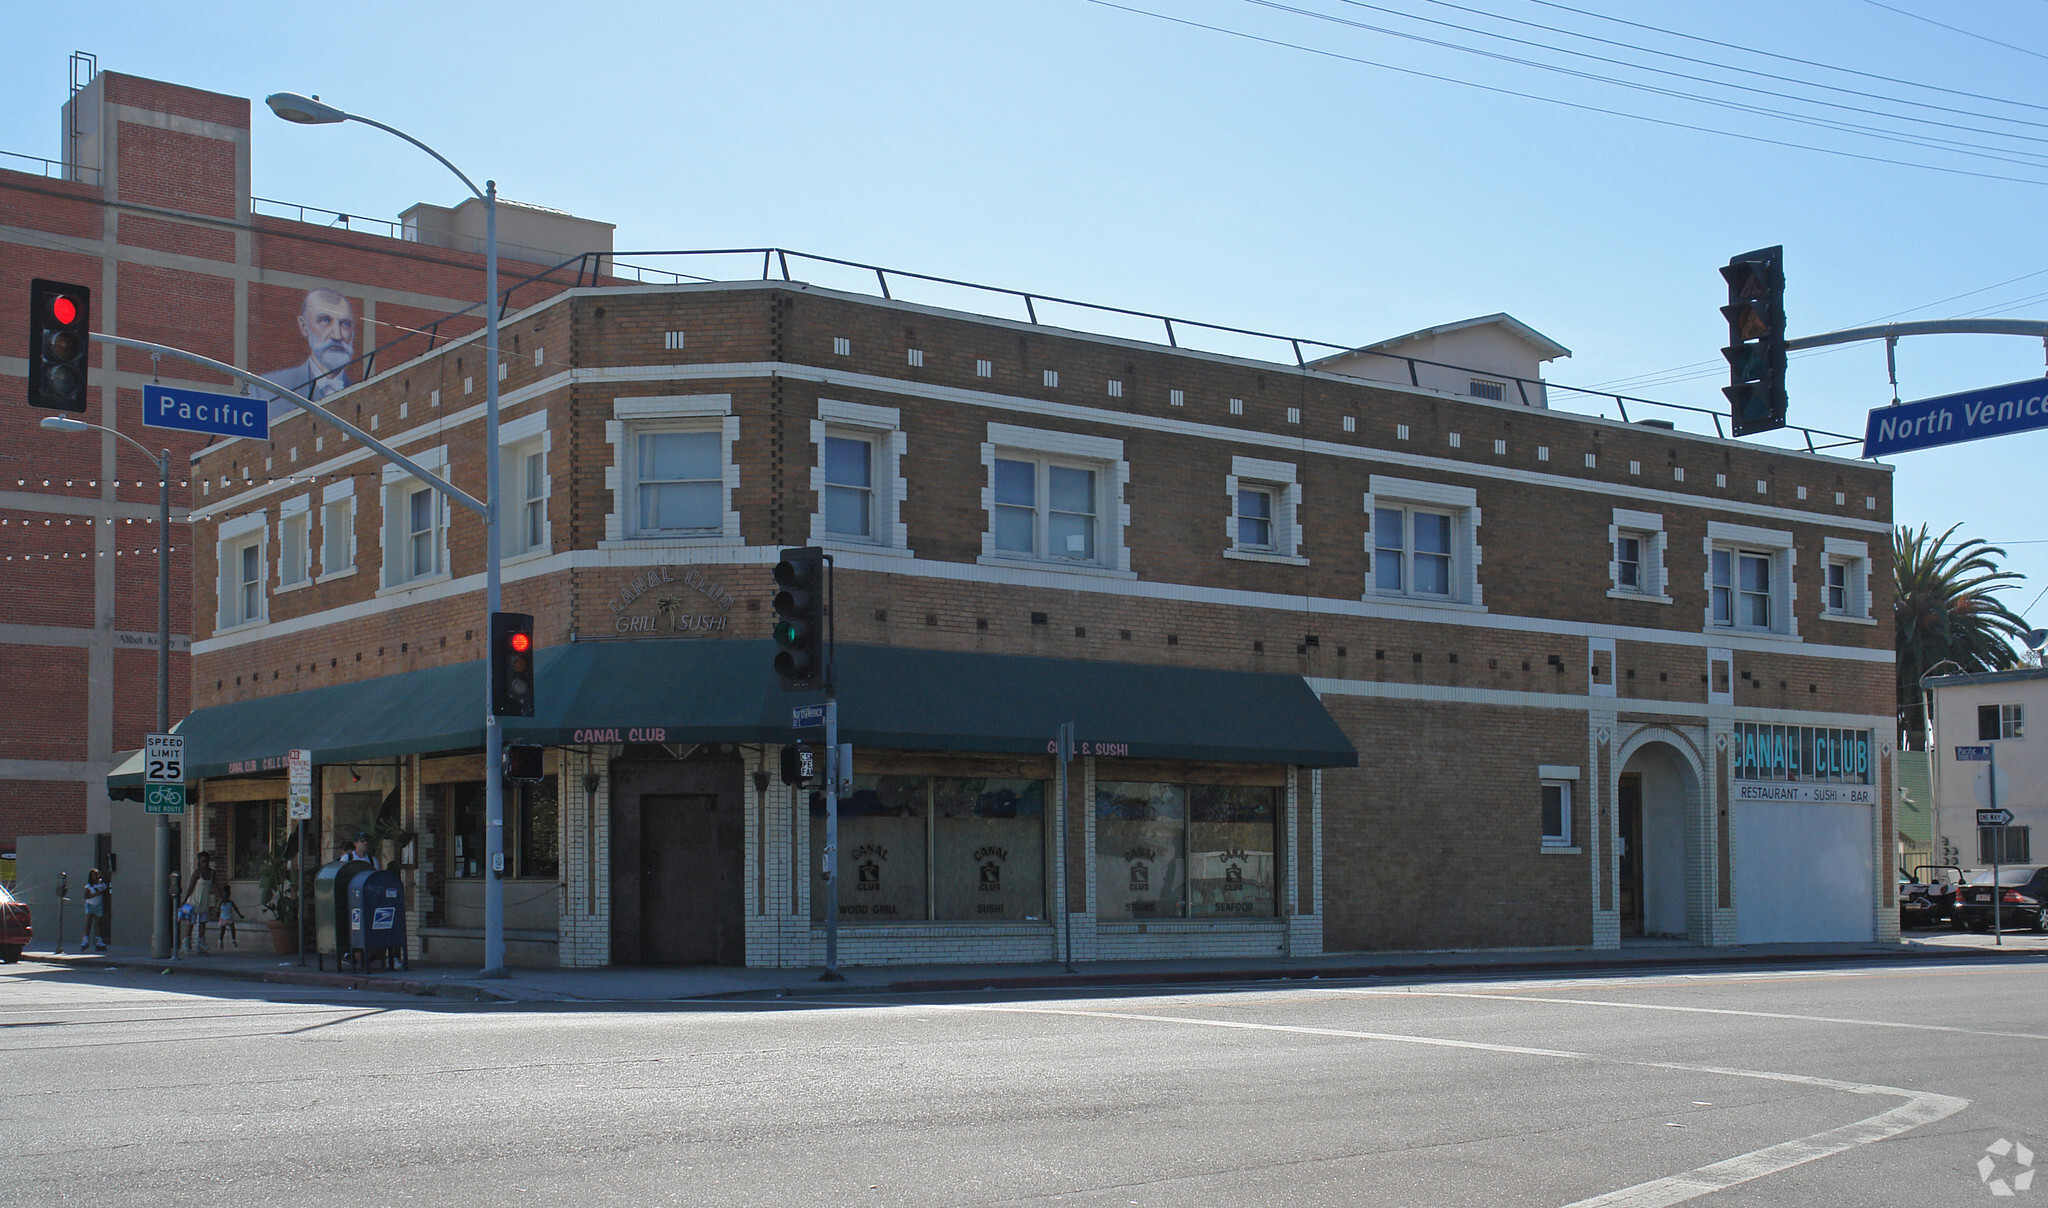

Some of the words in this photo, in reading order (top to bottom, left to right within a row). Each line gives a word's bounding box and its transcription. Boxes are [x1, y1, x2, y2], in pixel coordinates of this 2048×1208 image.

[160, 395, 254, 427] Pacific
[1878, 408, 1953, 443] North
[608, 566, 673, 613] CANAL
[684, 569, 734, 611] CLUB
[615, 615, 659, 633] GRILL
[679, 614, 727, 631] SUSHI
[119, 634, 143, 646] Abbot
[574, 728, 623, 743] CANAL
[628, 727, 666, 742] CLUB
[148, 738, 183, 747] SPEED
[1082, 742, 1091, 755] &
[1095, 742, 1128, 756] SUSHI
[151, 749, 180, 758] LIMIT
[1735, 732, 1798, 769] CANAL
[1816, 737, 1867, 773] CLUB
[1958, 747, 1977, 755] Pacific
[149, 760, 181, 779] 25
[229, 761, 244, 774] CANAL
[244, 759, 257, 772] CLUB
[1741, 787, 1798, 800] RESTAURANT
[1813, 789, 1838, 801] SUSHI
[1851, 791, 1868, 802] BAR
[852, 844, 888, 861] CANAL
[974, 846, 1008, 861] CANAL
[1220, 849, 1249, 864] CANAL
[857, 883, 881, 891] CLUB
[979, 883, 1001, 892] CLUB
[1129, 882, 1149, 891] CLUB
[1225, 883, 1243, 891] CLUB
[838, 904, 868, 914] WOOD
[872, 904, 898, 914] GRILL
[976, 903, 1004, 914] SUSHI
[1215, 902, 1254, 911] SEAFOOD
